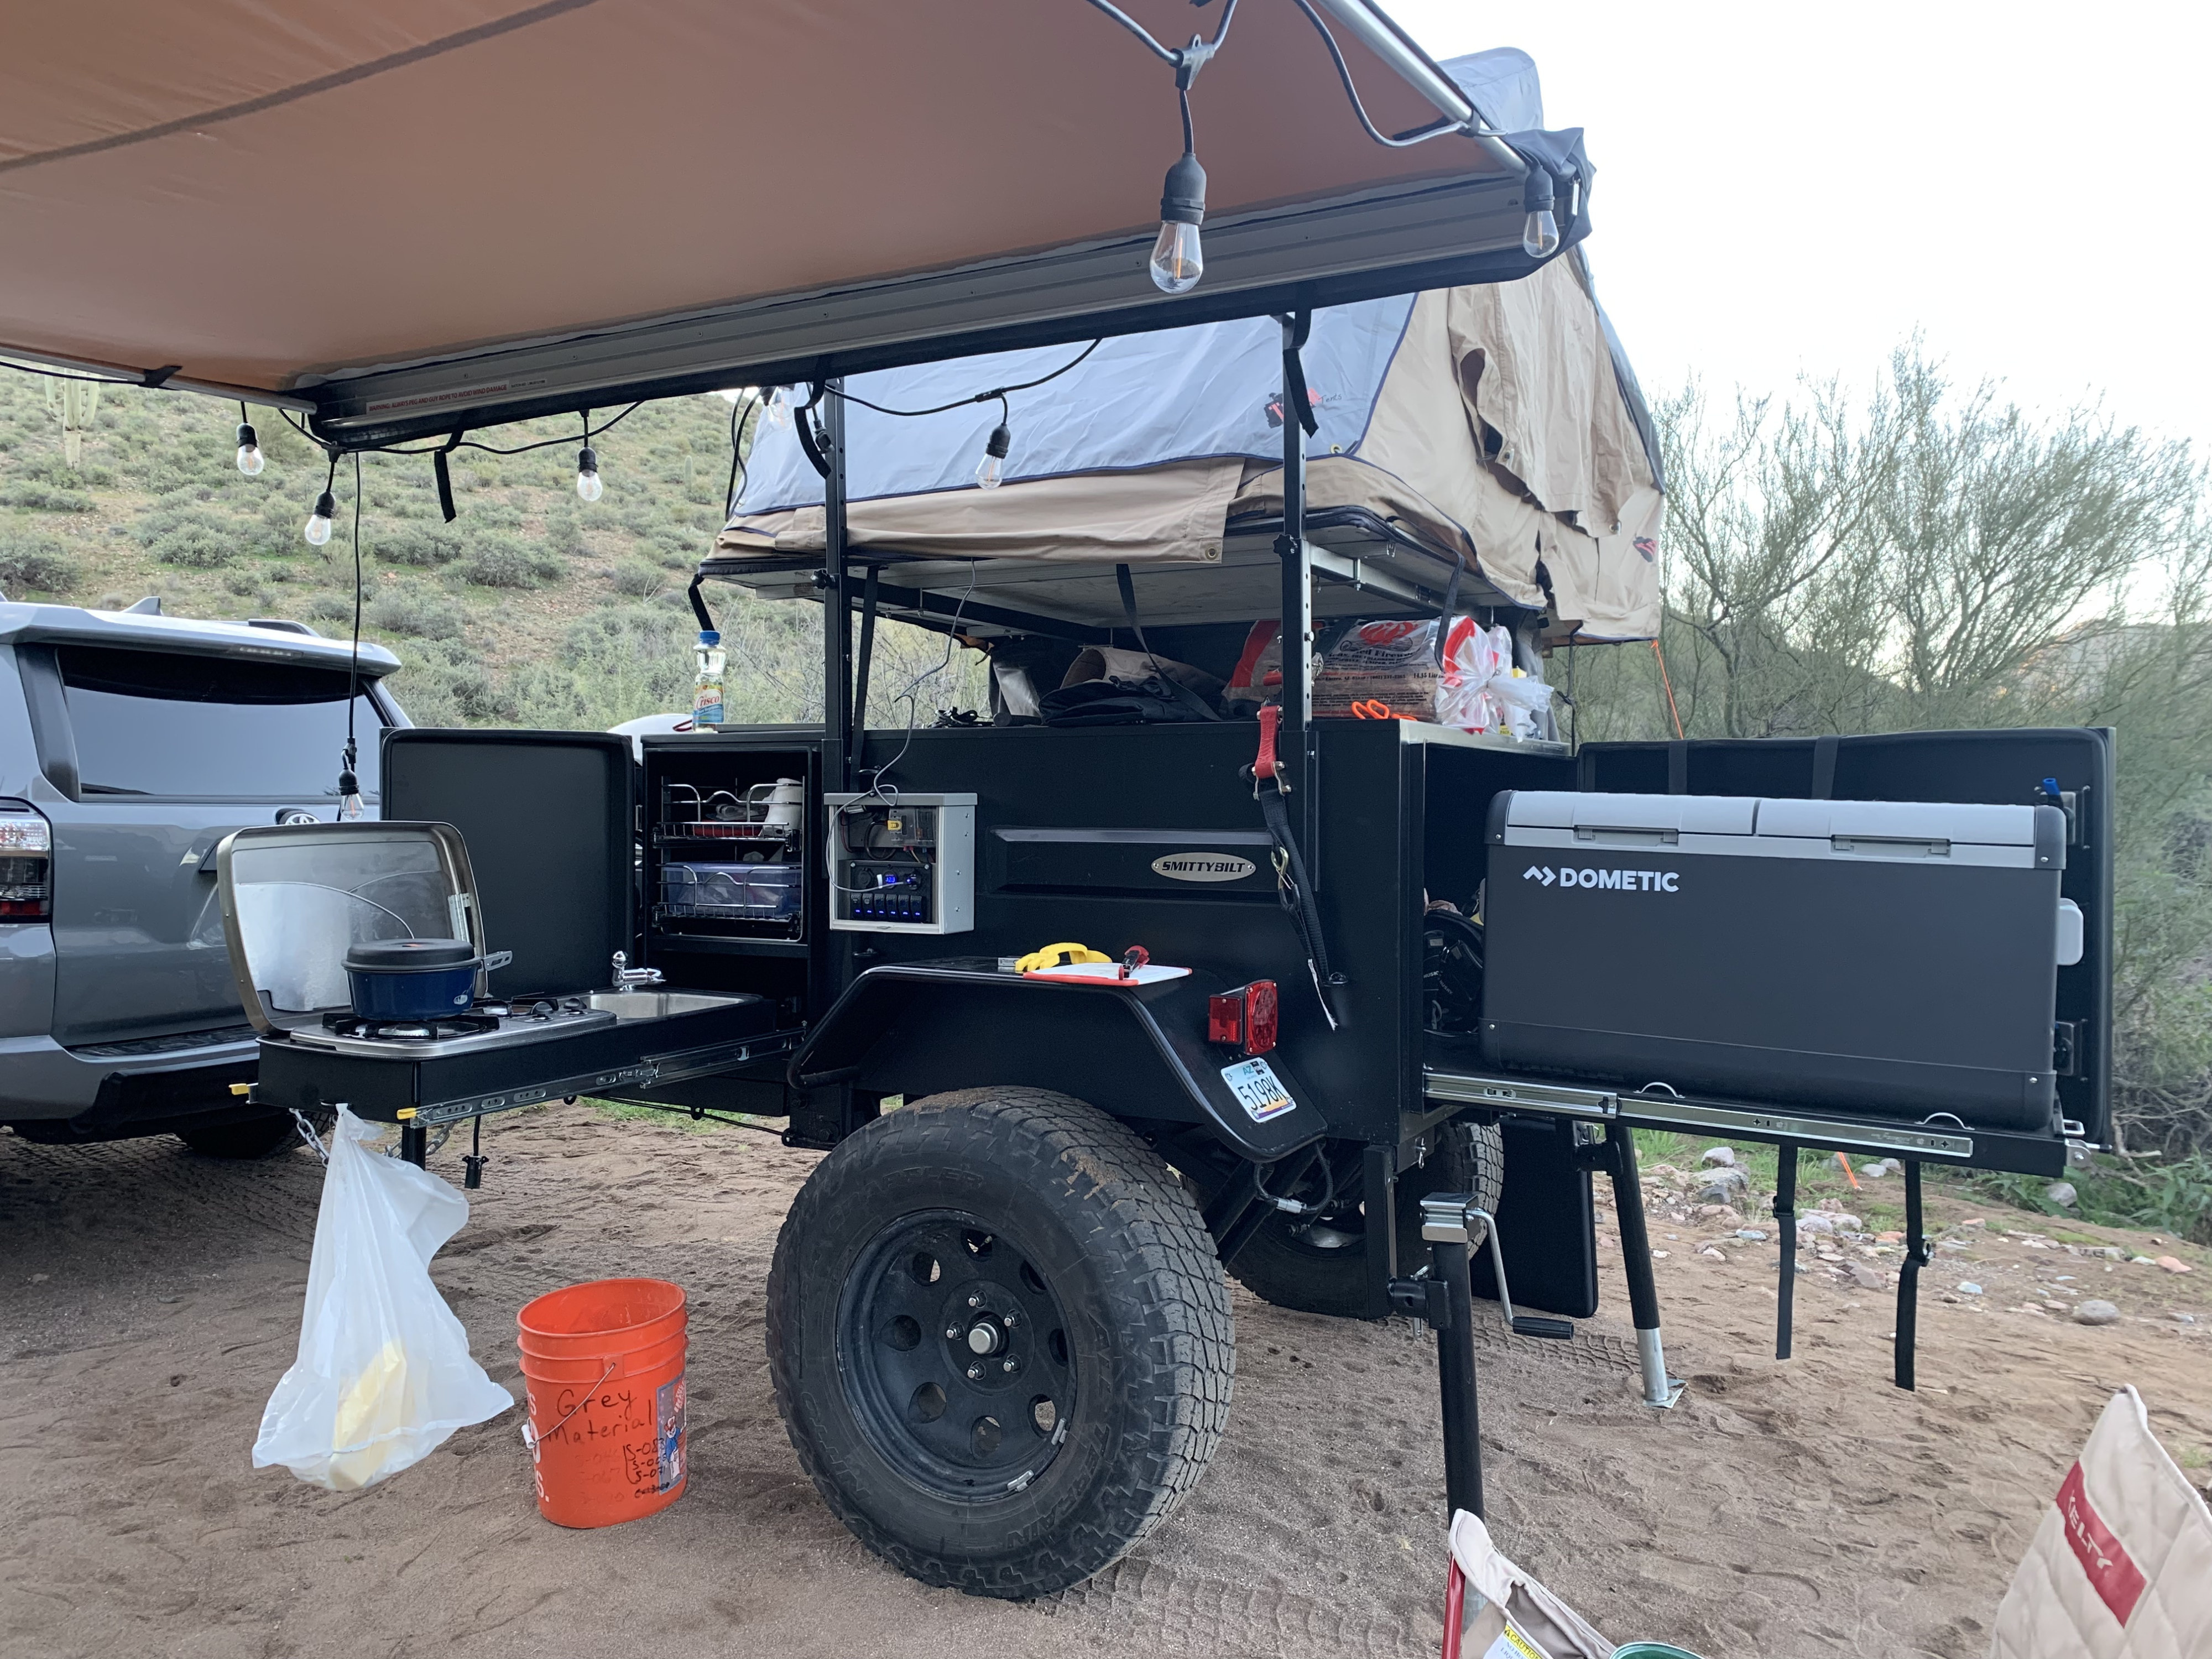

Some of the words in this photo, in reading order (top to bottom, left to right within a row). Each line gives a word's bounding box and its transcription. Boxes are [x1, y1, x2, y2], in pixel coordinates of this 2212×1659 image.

[369, 403, 390, 411] WARNING:
[486, 384, 507, 393] DAMAGE
[696, 695, 720, 710] Crisco
[1162, 861, 1245, 873] SMITTYBILT
[1559, 867, 1680, 893] DOMETIC
[1243, 1066, 1254, 1075] AZ
[1237, 1076, 1287, 1110] 5198K
[557, 1389, 637, 1421] Grey
[546, 1400, 652, 1444] Material
